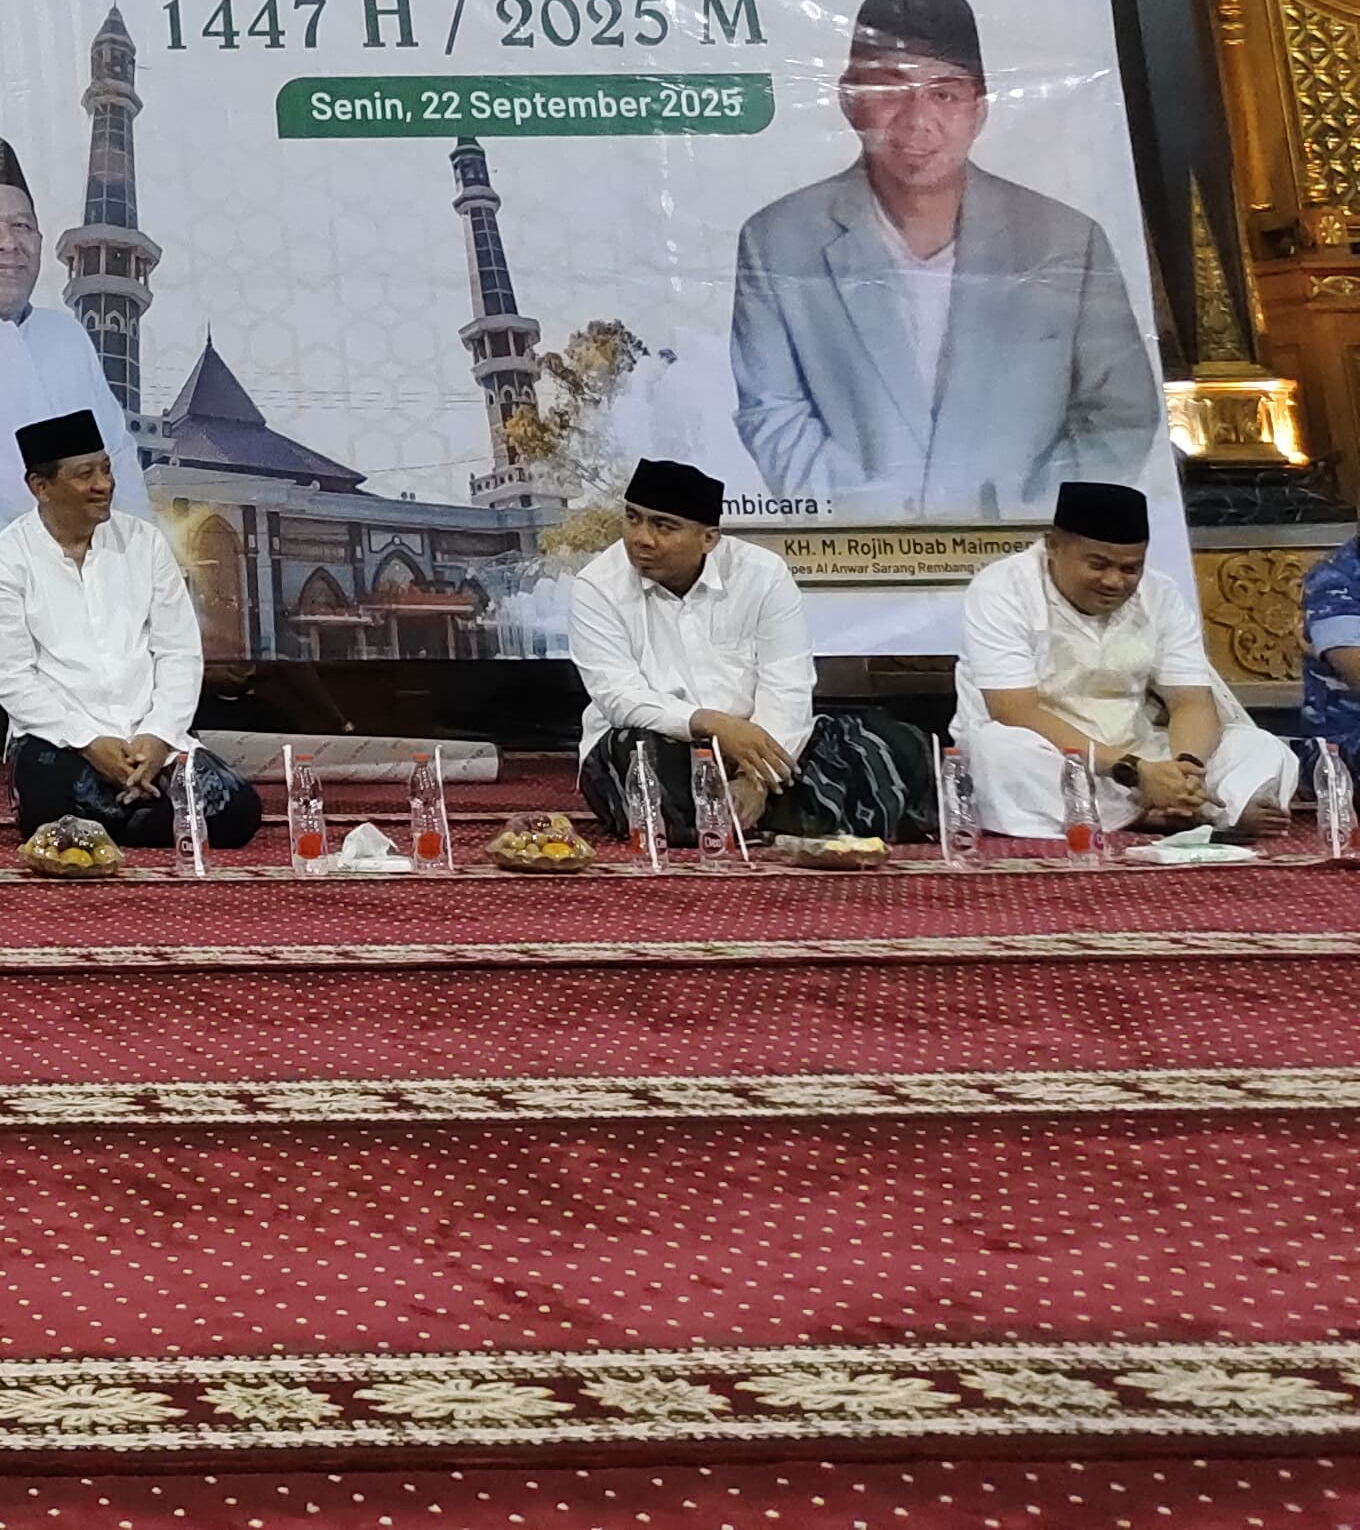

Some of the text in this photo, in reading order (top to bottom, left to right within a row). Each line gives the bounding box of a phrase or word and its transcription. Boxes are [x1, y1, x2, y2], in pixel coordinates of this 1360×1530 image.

[310, 88, 744, 125] Senin, 22 September 2025
[720, 493, 819, 516] mbicara
[783, 538, 817, 557] KH.
[821, 538, 842, 556] M.
[898, 537, 947, 555] Ubab
[831, 562, 870, 575] Anwar
[871, 562, 916, 576] Sarang
[917, 561, 975, 575] Rembang
